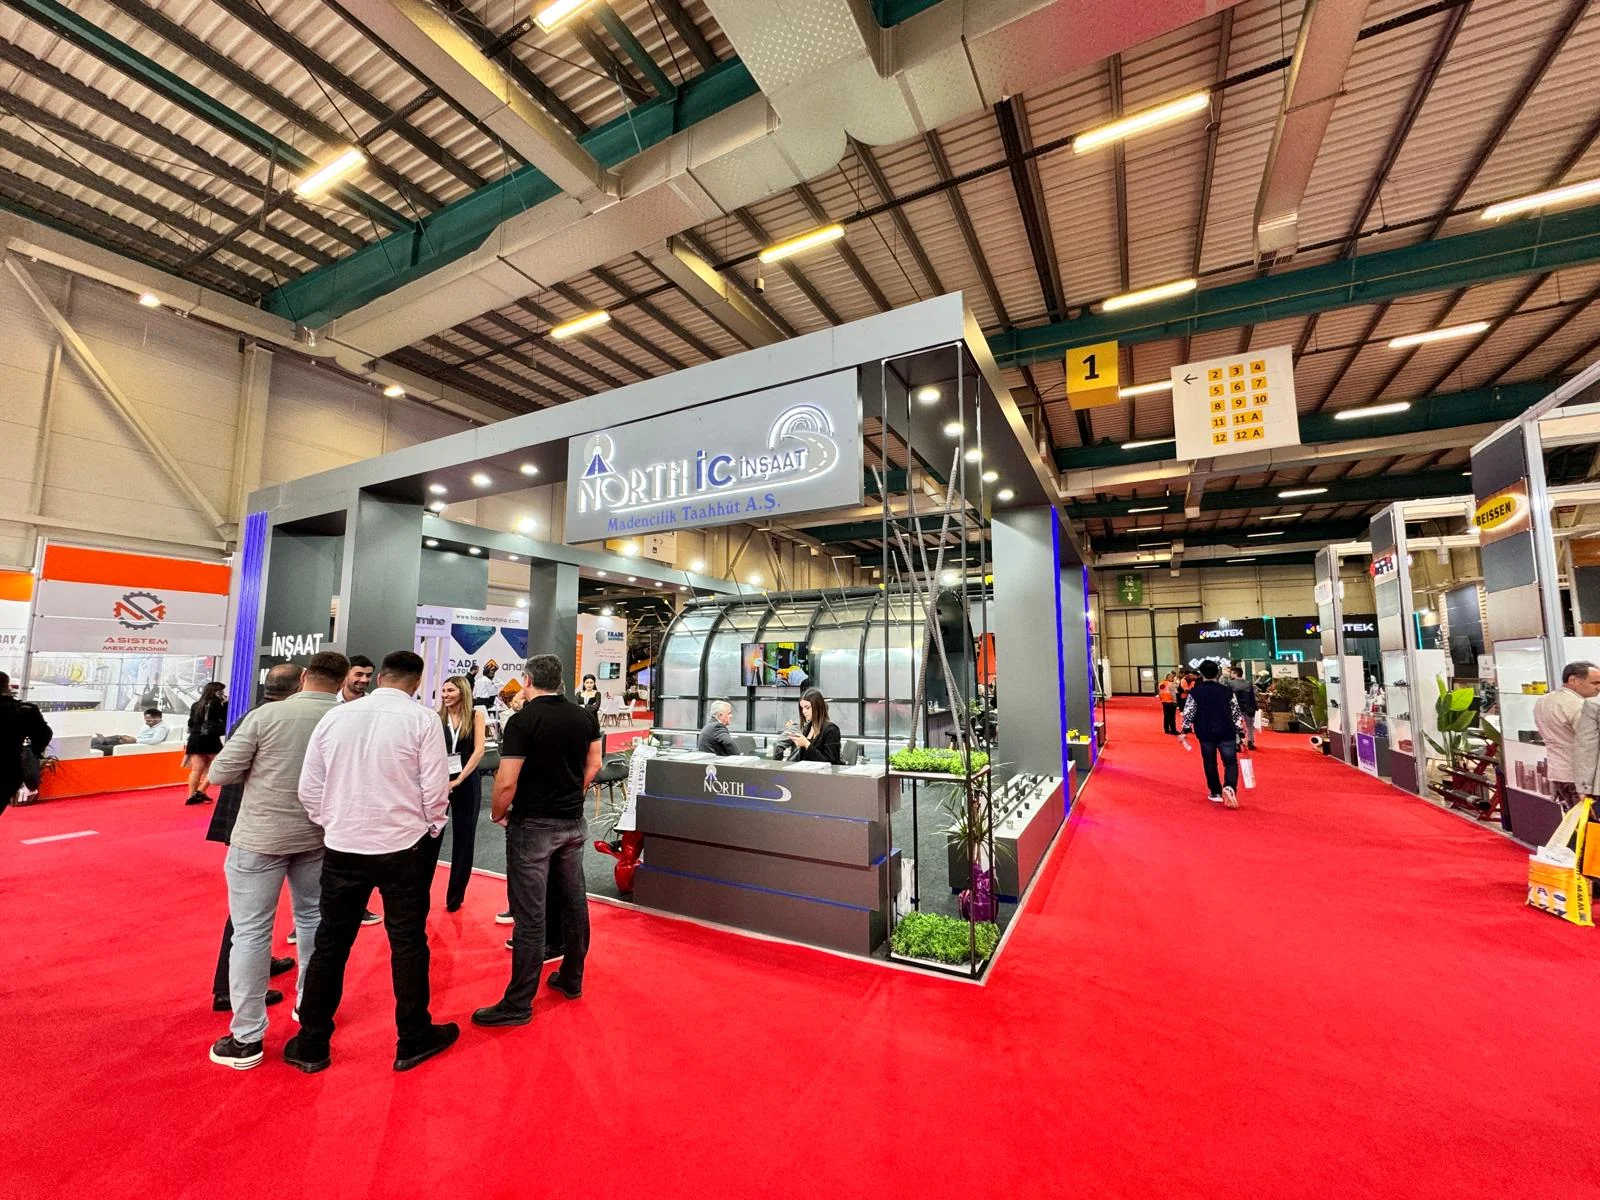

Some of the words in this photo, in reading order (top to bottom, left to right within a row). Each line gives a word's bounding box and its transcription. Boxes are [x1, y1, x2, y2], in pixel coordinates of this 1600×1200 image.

[1082, 354, 1100, 380] 1
[1212, 371, 1218, 379] 2
[1233, 367, 1240, 376] 3
[1254, 363, 1261, 371] 4
[1213, 387, 1220, 395] 5
[1234, 383, 1241, 391] 6
[1255, 379, 1262, 388] 7
[1214, 402, 1221, 411] 8
[1235, 399, 1242, 407] 9
[1255, 395, 1267, 404] 10
[1214, 418, 1225, 427] 11
[1235, 415, 1246, 423] 11
[1252, 412, 1259, 421] A
[1215, 434, 1226, 442] 12
[1236, 431, 1247, 440] 12
[1253, 429, 1261, 437] A
[578, 458, 690, 513] NORTH
[739, 448, 809, 480] İNŞAAT
[606, 512, 678, 533] Madencilik
[682, 501, 741, 521] Taahhüt
[745, 492, 782, 513] A.Ş.
[1475, 501, 1512, 527] BEISSEN
[1204, 629, 1244, 638] KONTEK
[271, 631, 324, 662] İNŞAAT
[703, 779, 744, 796] NORTH
